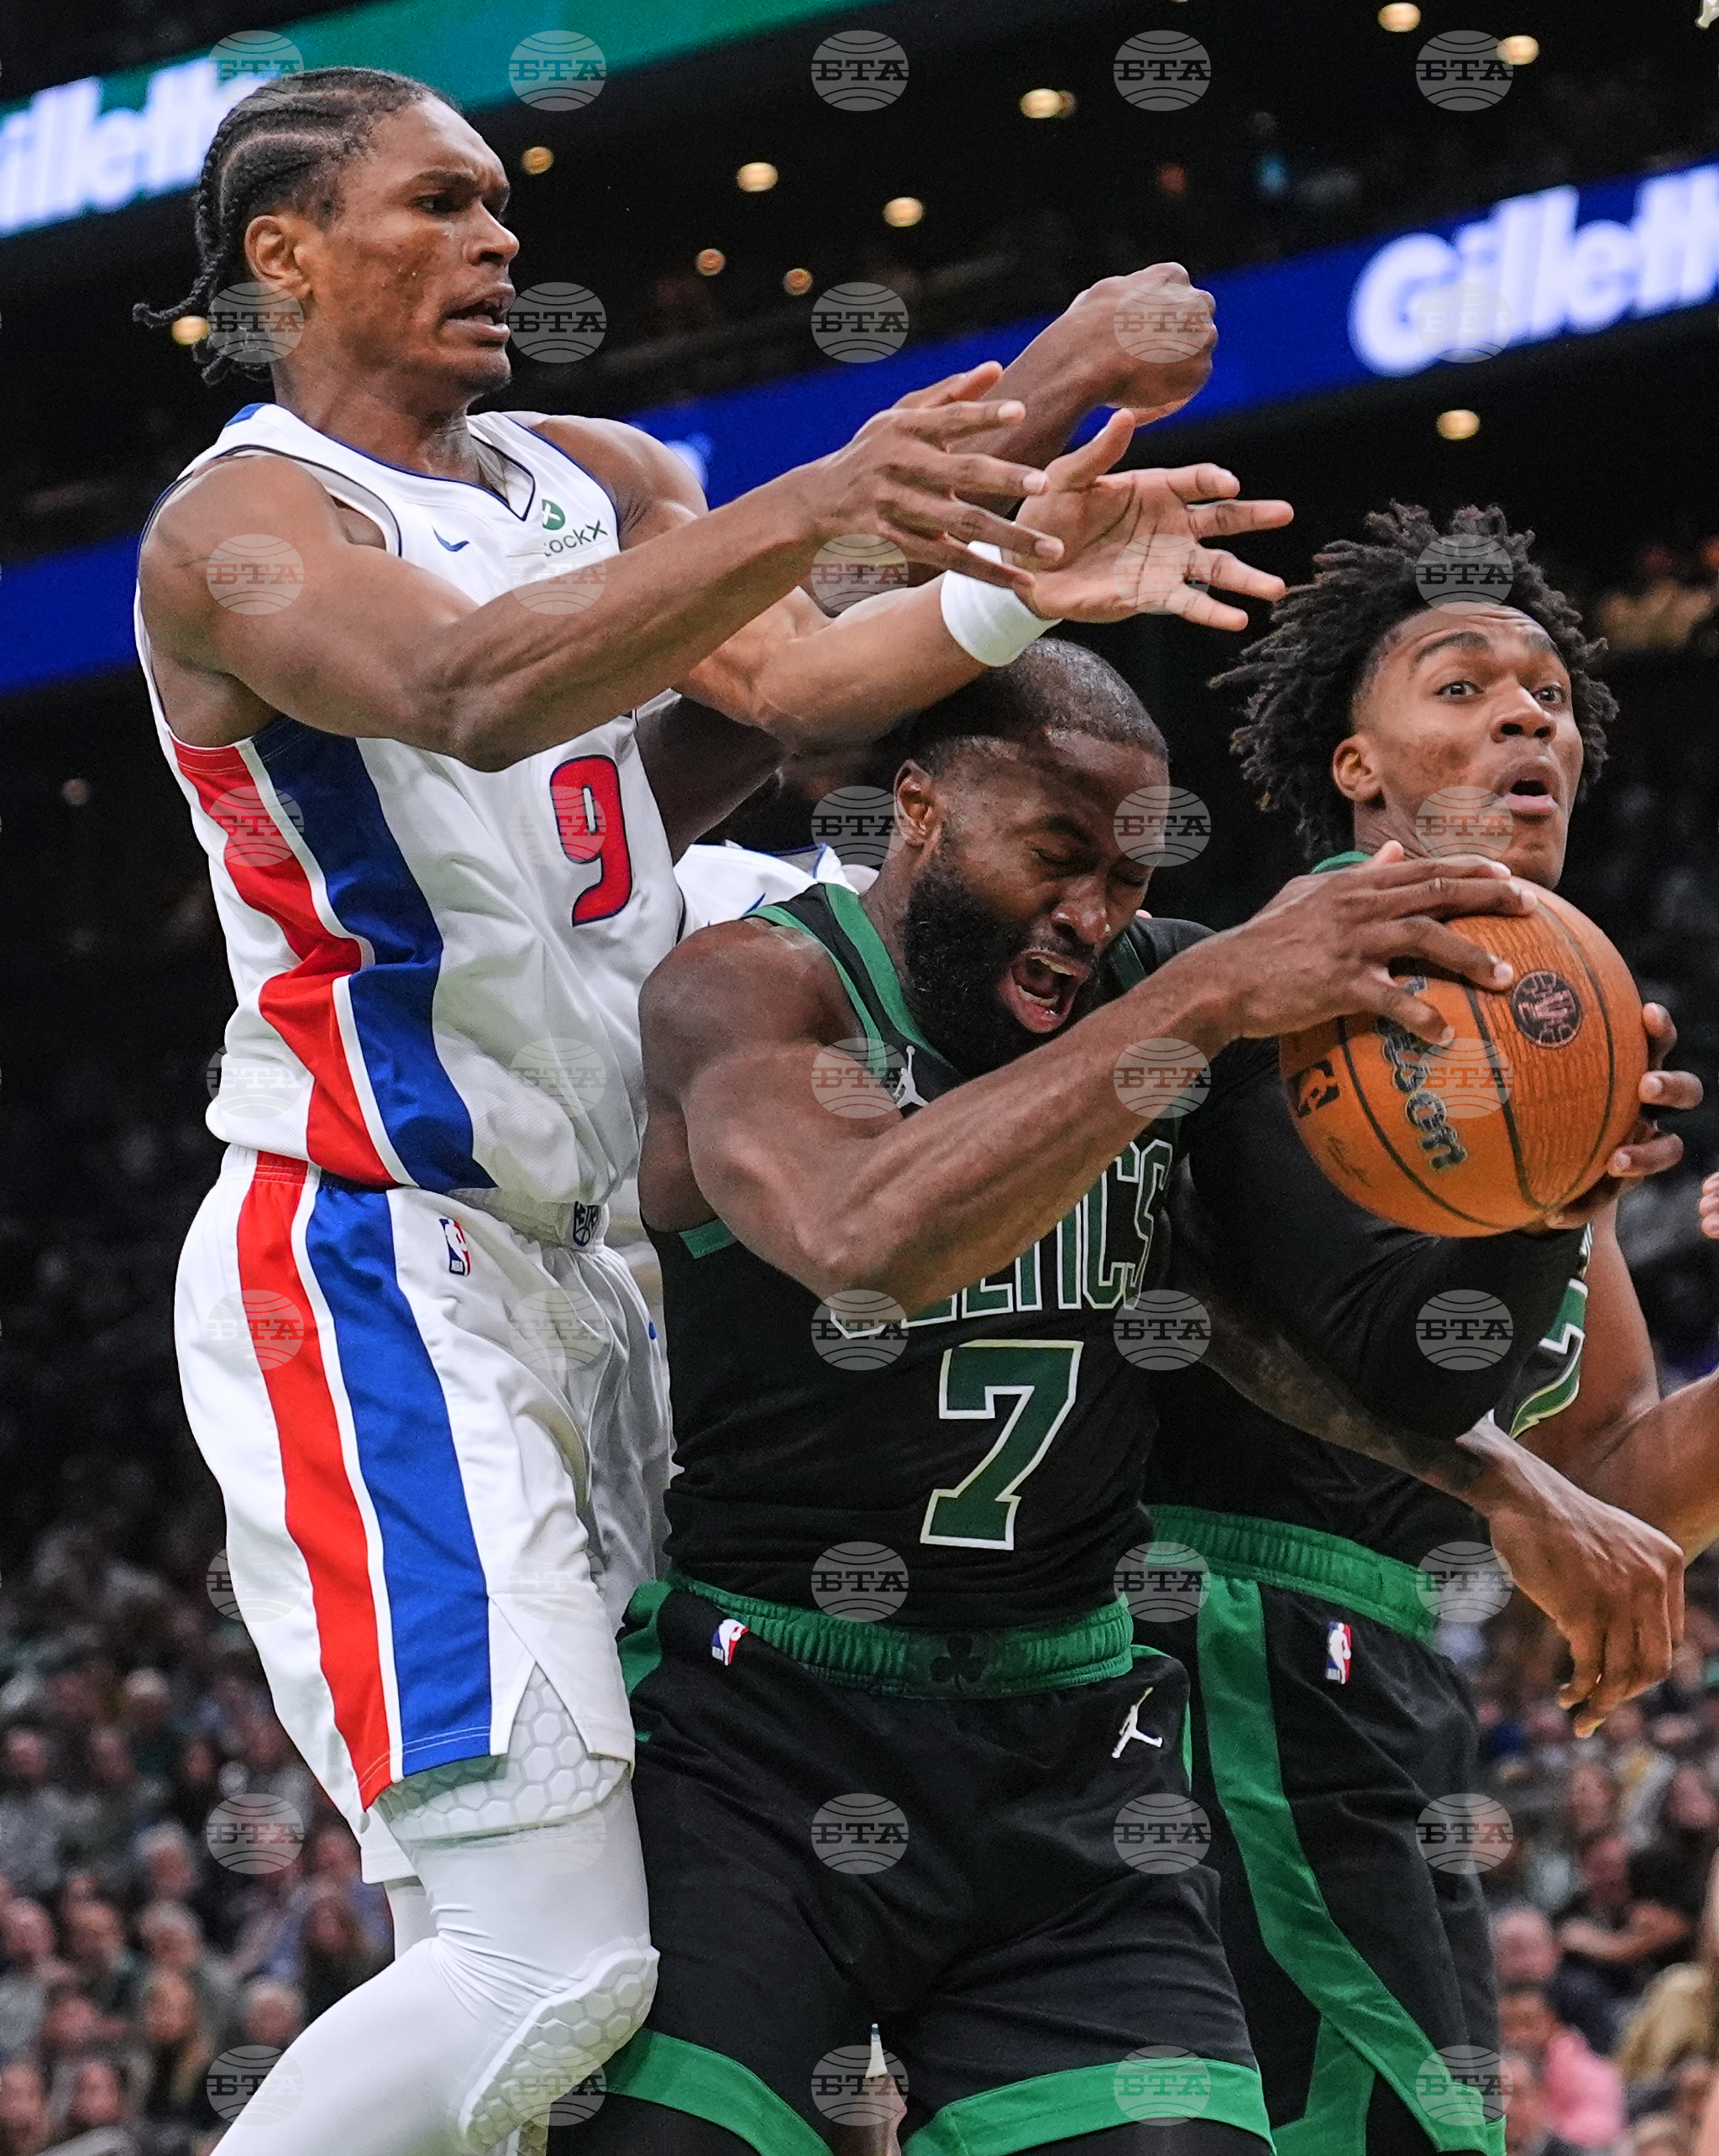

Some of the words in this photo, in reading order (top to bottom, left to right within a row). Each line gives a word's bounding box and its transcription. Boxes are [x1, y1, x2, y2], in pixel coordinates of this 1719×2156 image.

[0, 55, 270, 238] illett
[1347, 163, 1719, 378] Gillett
[543, 519, 608, 557] ockX
[550, 754, 632, 928] 9
[1376, 979, 1468, 1172] son
[920, 1339, 1084, 1551] 7
